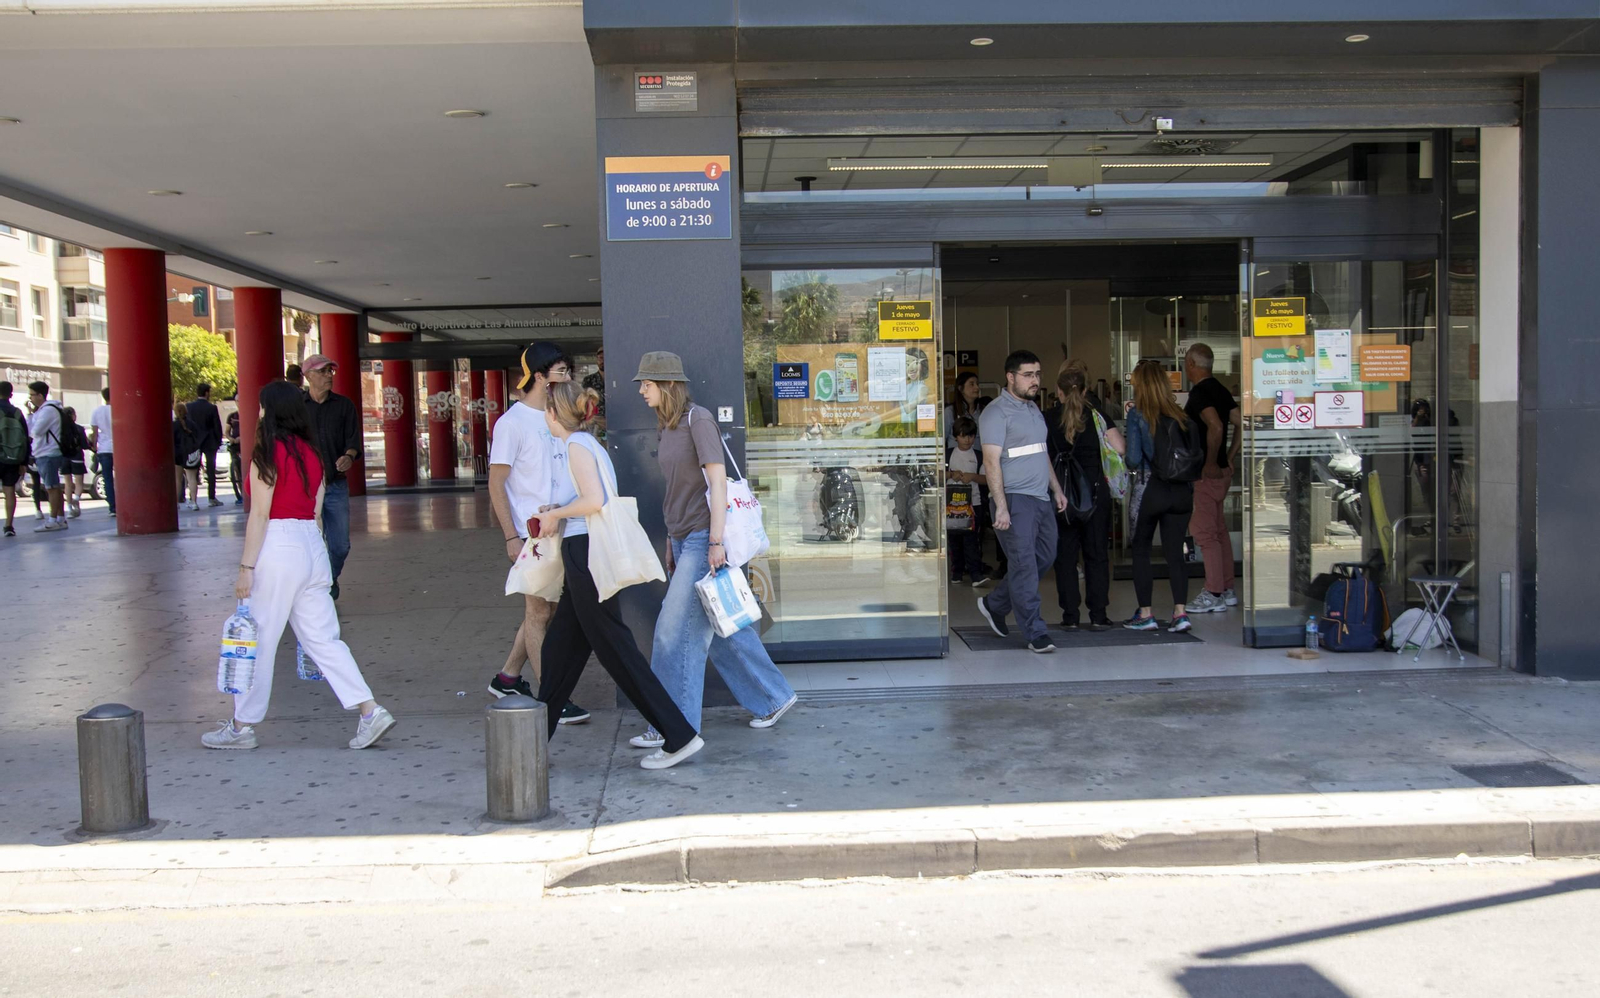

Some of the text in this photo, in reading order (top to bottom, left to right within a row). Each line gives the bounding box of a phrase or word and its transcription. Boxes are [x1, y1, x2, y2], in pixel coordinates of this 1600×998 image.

[616, 182, 720, 194] HORARIO DE APERTURA
[626, 197, 711, 210] lunes a sábado
[626, 214, 712, 228] de 9:00 a 21:30
[420, 319, 467, 332] Deportivo
[469, 318, 481, 329] de
[484, 318, 502, 328] Las
[504, 317, 571, 328] Almadrabillas
